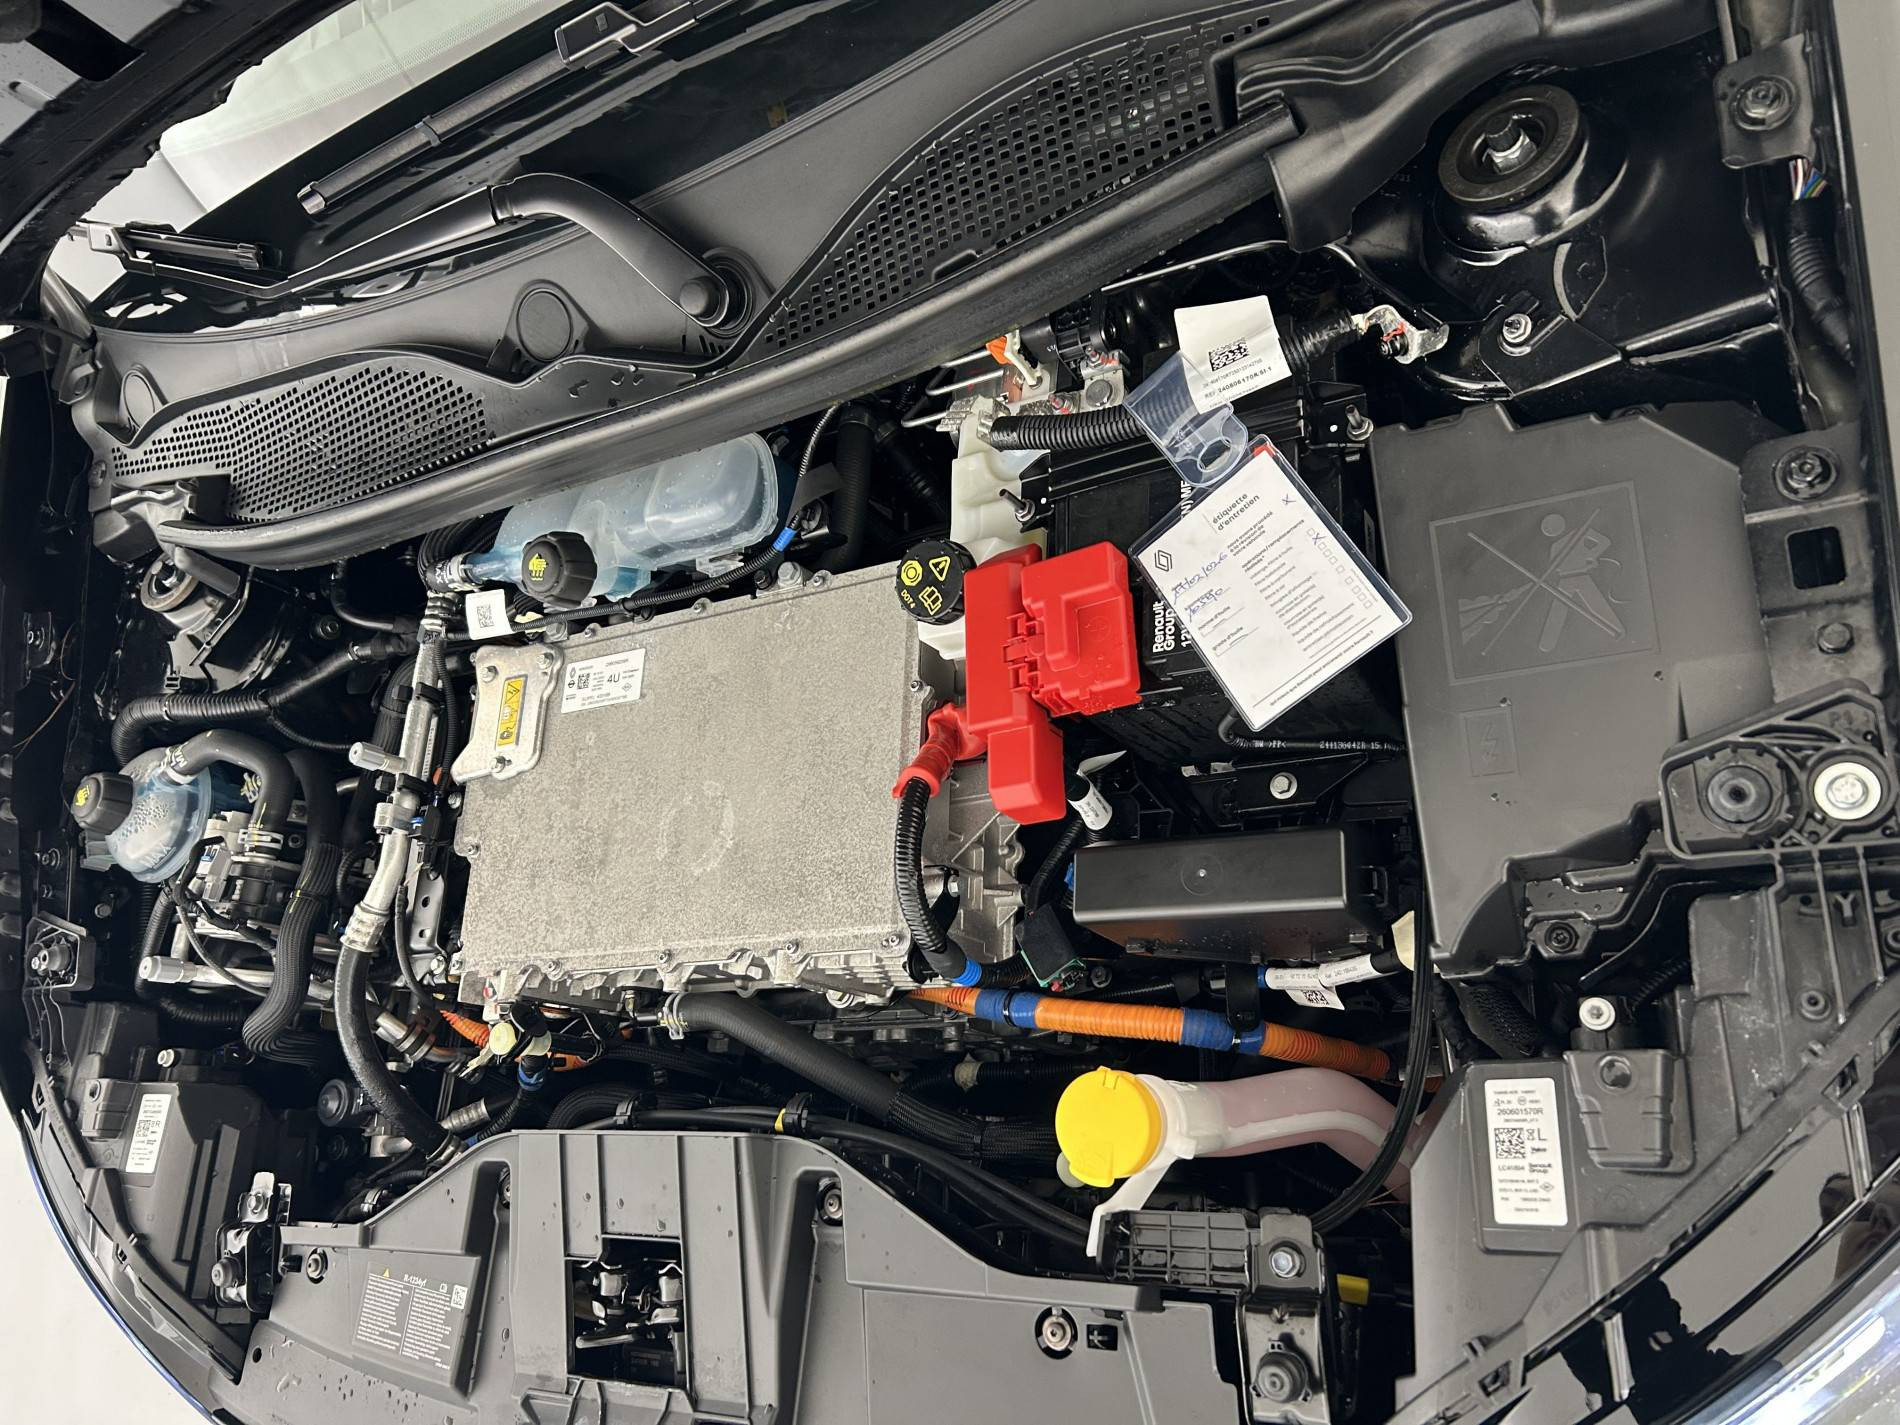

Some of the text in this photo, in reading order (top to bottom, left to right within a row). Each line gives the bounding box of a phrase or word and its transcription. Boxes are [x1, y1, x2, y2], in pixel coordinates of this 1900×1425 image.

[1212, 493, 1247, 523] étiquette
[1217, 495, 1260, 530] d'entretien
[1153, 600, 1165, 653] Renault
[1164, 608, 1177, 652] Group
[607, 673, 621, 684] 4U
